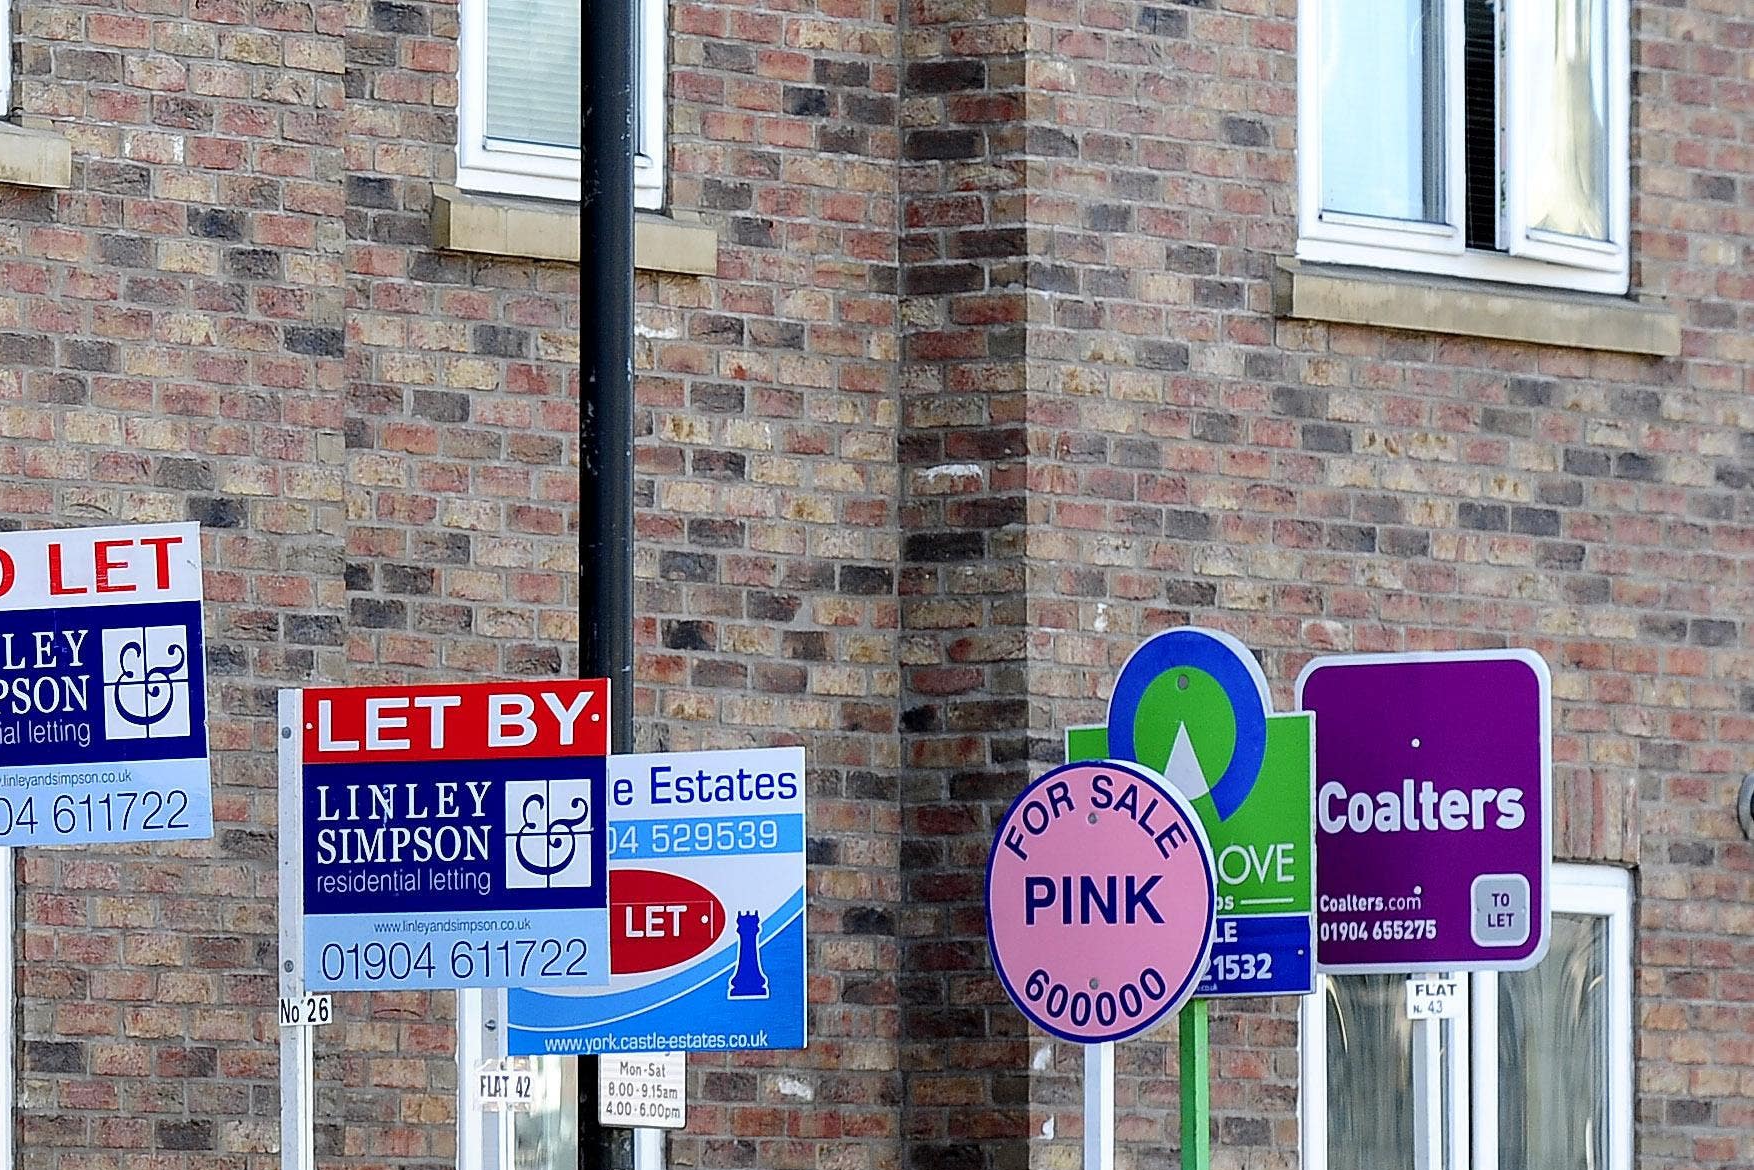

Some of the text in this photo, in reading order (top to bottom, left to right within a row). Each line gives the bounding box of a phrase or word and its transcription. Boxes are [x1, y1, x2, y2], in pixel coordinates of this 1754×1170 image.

[48, 537, 183, 595] LET
[29, 720, 91, 747] letting
[318, 690, 594, 752] LET BY
[317, 781, 491, 821] LINLEY
[651, 766, 797, 806] Estates
[53, 789, 189, 834] 611722
[1004, 774, 1188, 861] FOR SALE
[1319, 779, 1526, 834] Coalters
[317, 825, 491, 865] SIMPSON
[651, 820, 778, 853] 529539
[317, 867, 491, 895] residential letting
[1216, 842, 1294, 886] OVE
[1024, 873, 1165, 926] PINK
[1320, 893, 1422, 913] Coalters.com
[1492, 893, 1509, 907] TO
[373, 917, 532, 936] www.linleyandsimpson.co.uk
[625, 904, 688, 938] LET
[1320, 919, 1437, 942] 01904 655275
[1487, 914, 1514, 929] LET
[321, 938, 589, 981] 01904 611722
[1200, 952, 1273, 981] 21532
[1024, 967, 1166, 1027] 600000
[1415, 984, 1457, 996] FLAT
[280, 997, 329, 1024] No 26
[480, 1075, 531, 1098] FLAT 42
